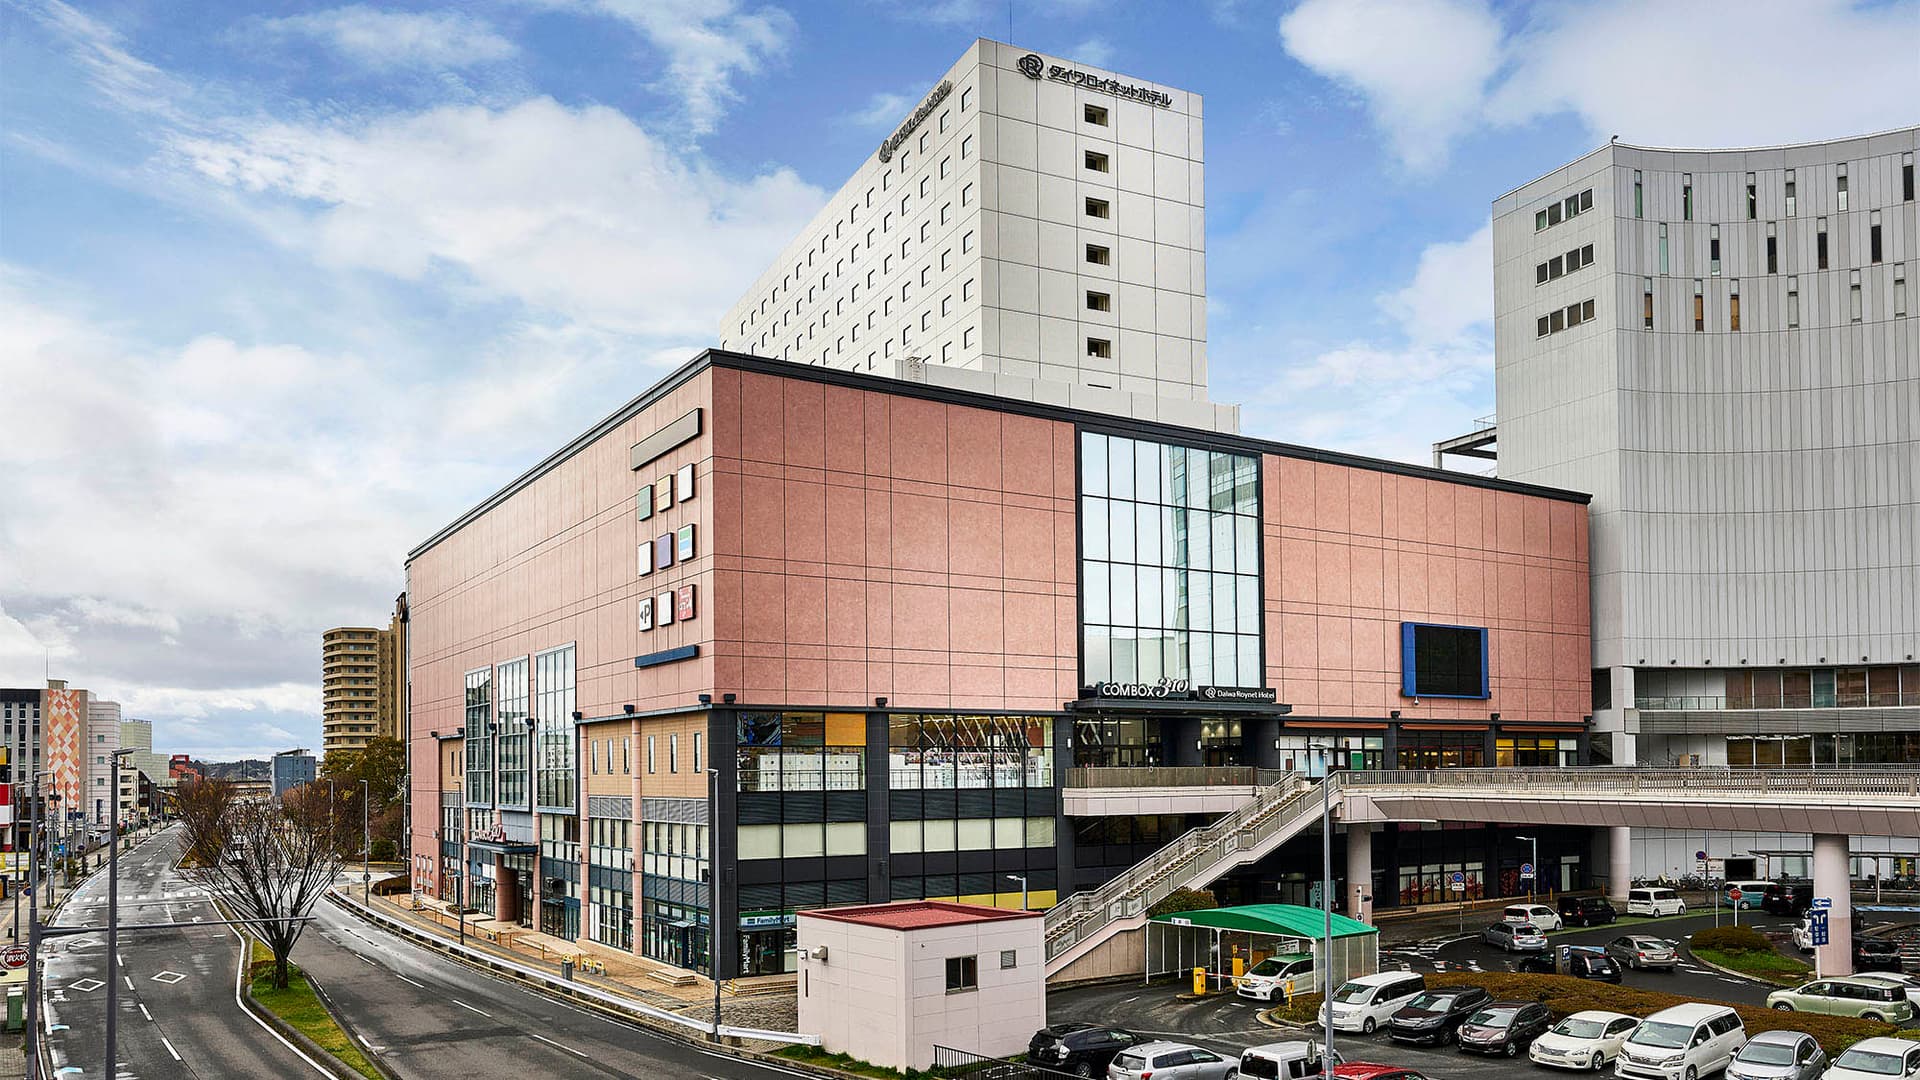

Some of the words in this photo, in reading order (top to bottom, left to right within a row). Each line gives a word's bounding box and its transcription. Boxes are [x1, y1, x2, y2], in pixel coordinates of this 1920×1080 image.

[1049, 65, 1172, 106] ダイワロイネットホテル
[1217, 690, 1236, 698] Daiwa
[1236, 690, 1258, 699] Roynet
[1258, 691, 1275, 699] Hotel
